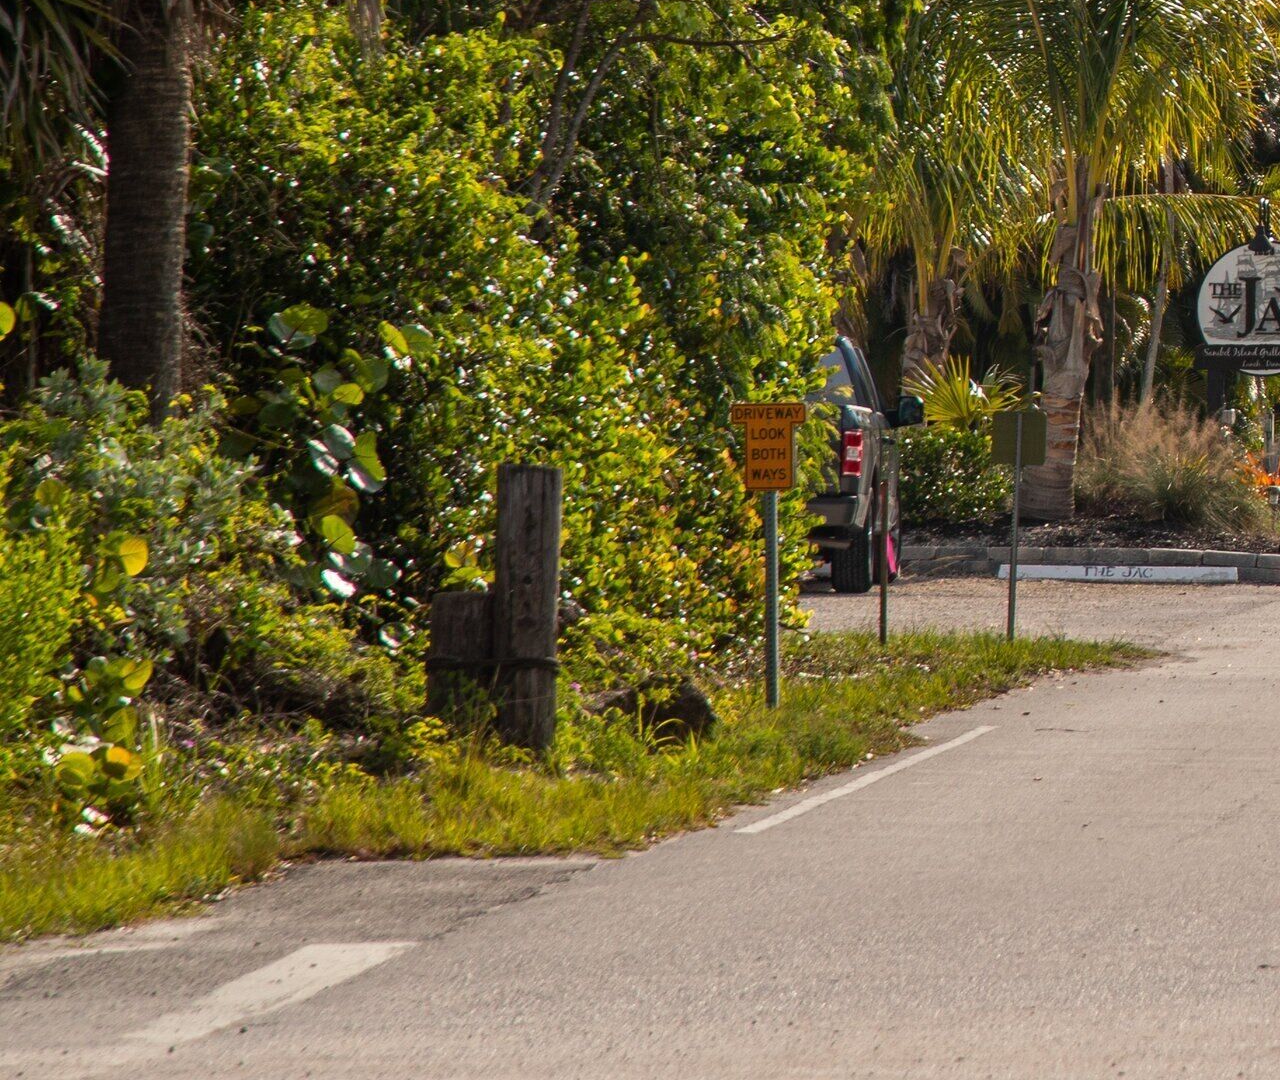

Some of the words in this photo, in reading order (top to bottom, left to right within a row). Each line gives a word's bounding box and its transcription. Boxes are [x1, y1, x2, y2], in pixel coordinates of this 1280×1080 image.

[1208, 282, 1242, 296] THE
[1232, 346, 1258, 357] Island
[735, 407, 802, 420] DRIVEWAY
[751, 427, 786, 440] LOOK
[751, 448, 786, 460] BOTH
[751, 468, 786, 480] WAYS
[1084, 565, 1114, 577] THE
